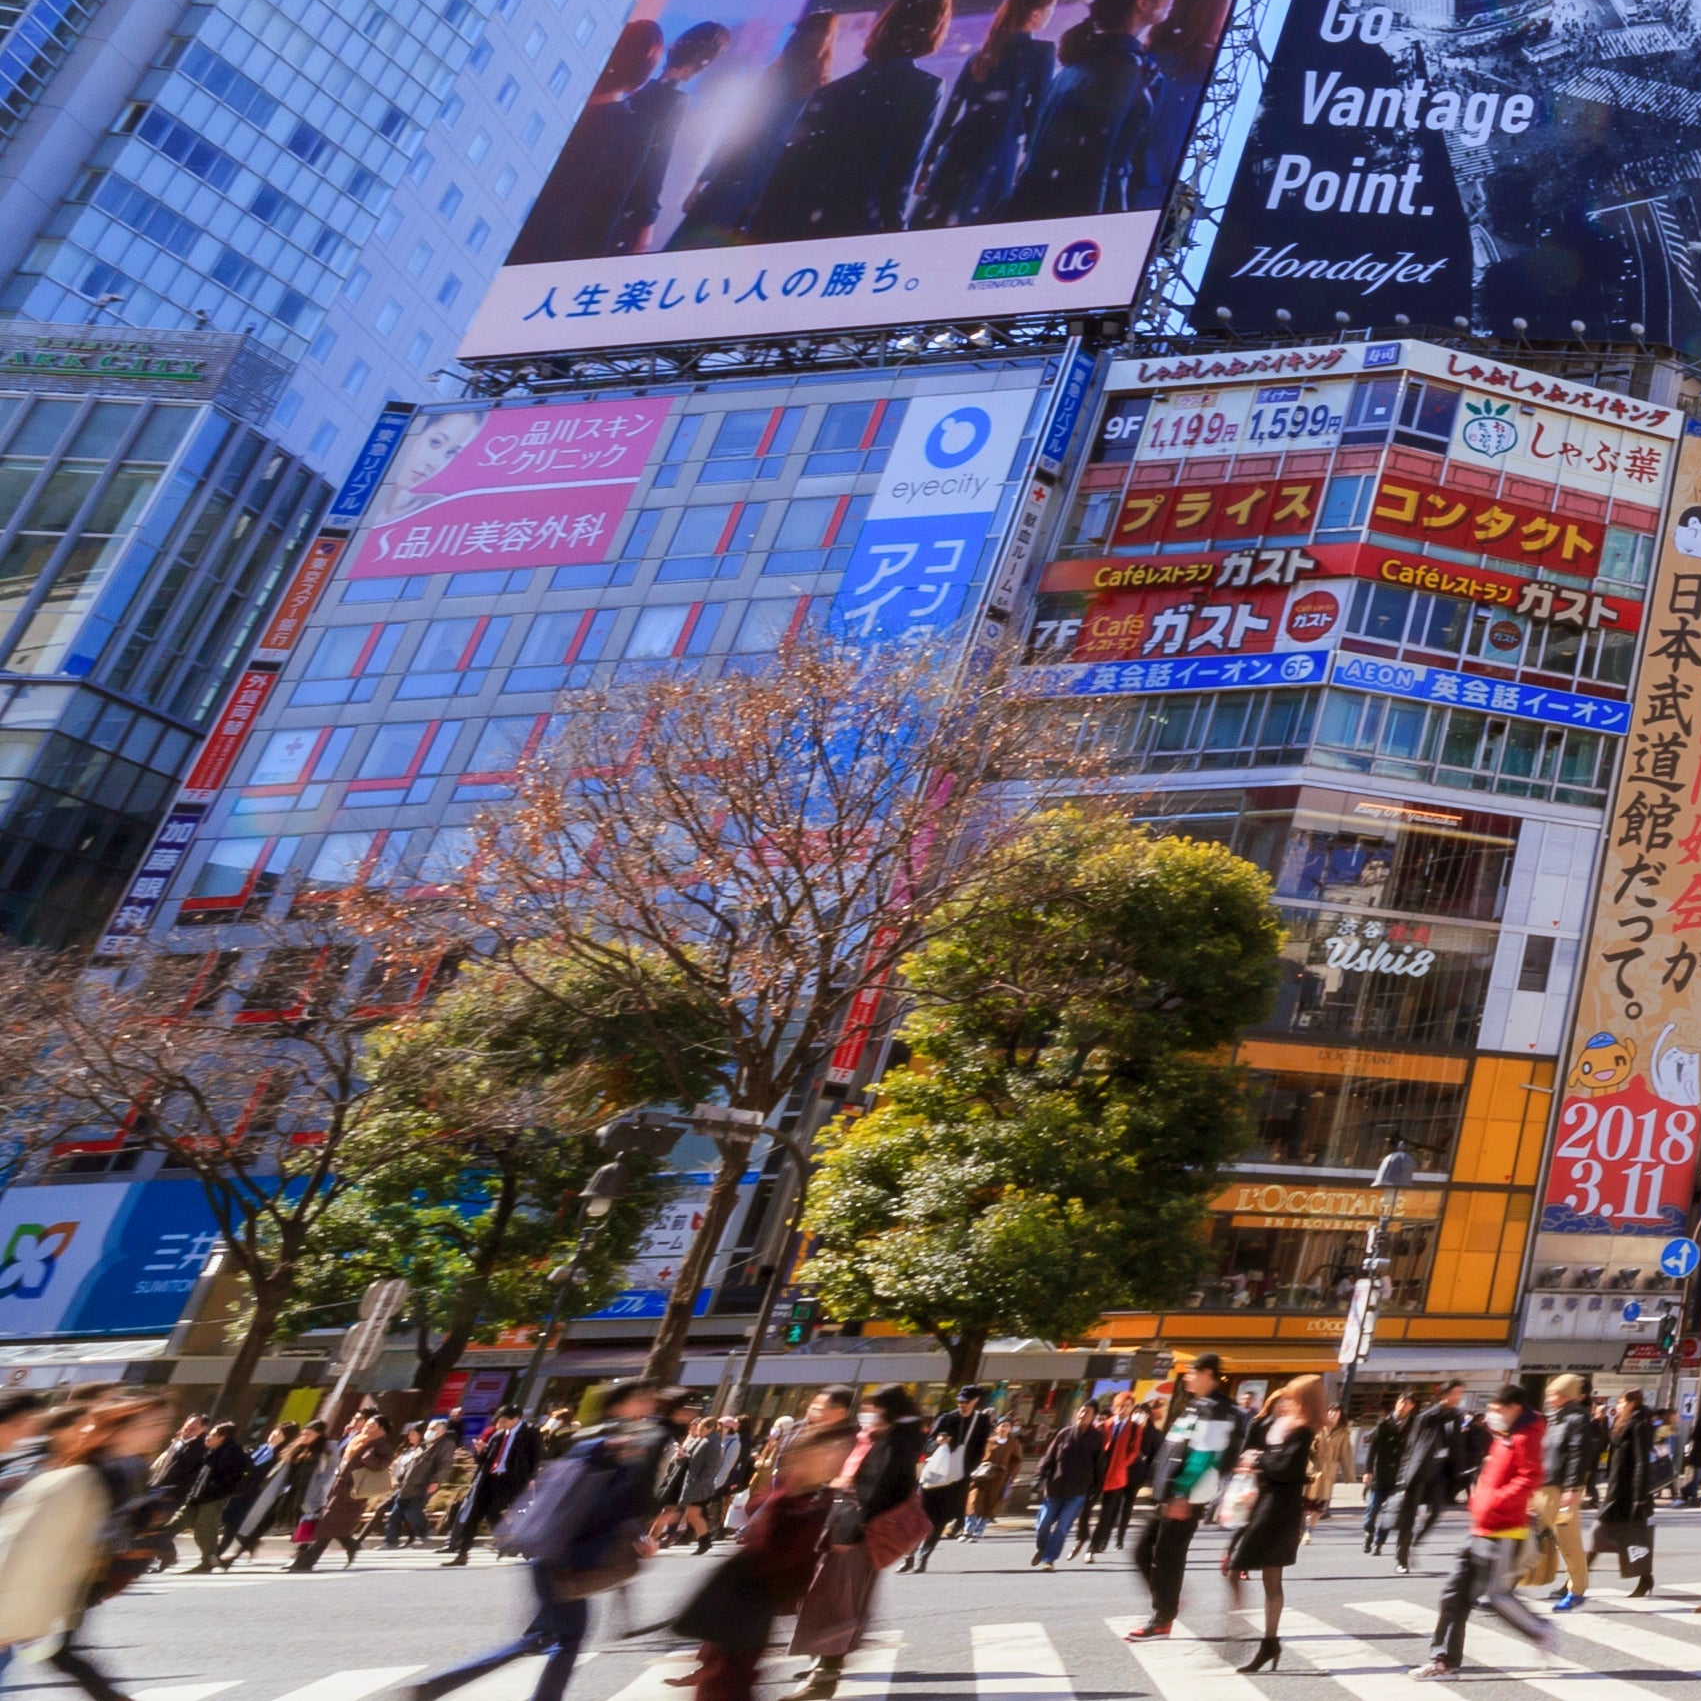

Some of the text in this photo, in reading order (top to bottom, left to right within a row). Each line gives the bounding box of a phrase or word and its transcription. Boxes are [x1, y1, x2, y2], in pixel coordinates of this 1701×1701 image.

[1301, 71, 1535, 148] Vantage
[1265, 154, 1435, 216] Point.
[980, 247, 1047, 264] SAISON
[984, 263, 1032, 278] CARD
[1231, 242, 1450, 296] HondaJet
[523, 257, 921, 322] 人生楽しい人の勝ち。
[967, 277, 1036, 291] INTERNATIONAL
[100, 354, 206, 373] CITY
[1138, 348, 1347, 383] しゃぶしゃぶバイキング
[1366, 346, 1397, 363] 寿司
[1047, 367, 1089, 454] 東急リバブル
[1260, 388, 1298, 401] ディナー
[1449, 353, 1671, 427] しゃぶしゃぶバイキング
[519, 412, 655, 447] 品川スキン
[1104, 415, 1143, 440] 9F
[1150, 412, 1239, 454] 1,199円
[1250, 404, 1342, 445] 1,599円
[336, 424, 399, 514] 東急リバブル
[511, 442, 628, 477] クリニック
[1530, 422, 1662, 484] しゃぶ葉
[890, 473, 992, 504] eyecity
[1121, 482, 1315, 534] プライス
[392, 511, 606, 561] 品川美容外科
[1375, 481, 1599, 560] コンタクト
[1214, 547, 1317, 588] ガスト
[1091, 613, 1145, 638] Café
[1291, 611, 1334, 629] ガスト
[1517, 581, 1619, 630] ガスト
[1033, 618, 1083, 648] 7F
[1142, 602, 1270, 655] ガスト
[1091, 659, 1273, 691] 英会話イーオン
[1344, 659, 1417, 690] AEON
[1431, 671, 1627, 728] 英会話イーオン
[116, 820, 190, 934] 加藤眼科
[1325, 937, 1436, 978] Ushi8
[1556, 1102, 1697, 1168] 2018
[1564, 1159, 1666, 1220] 3.11
[1264, 1217, 1376, 1232] EN PROVENC
